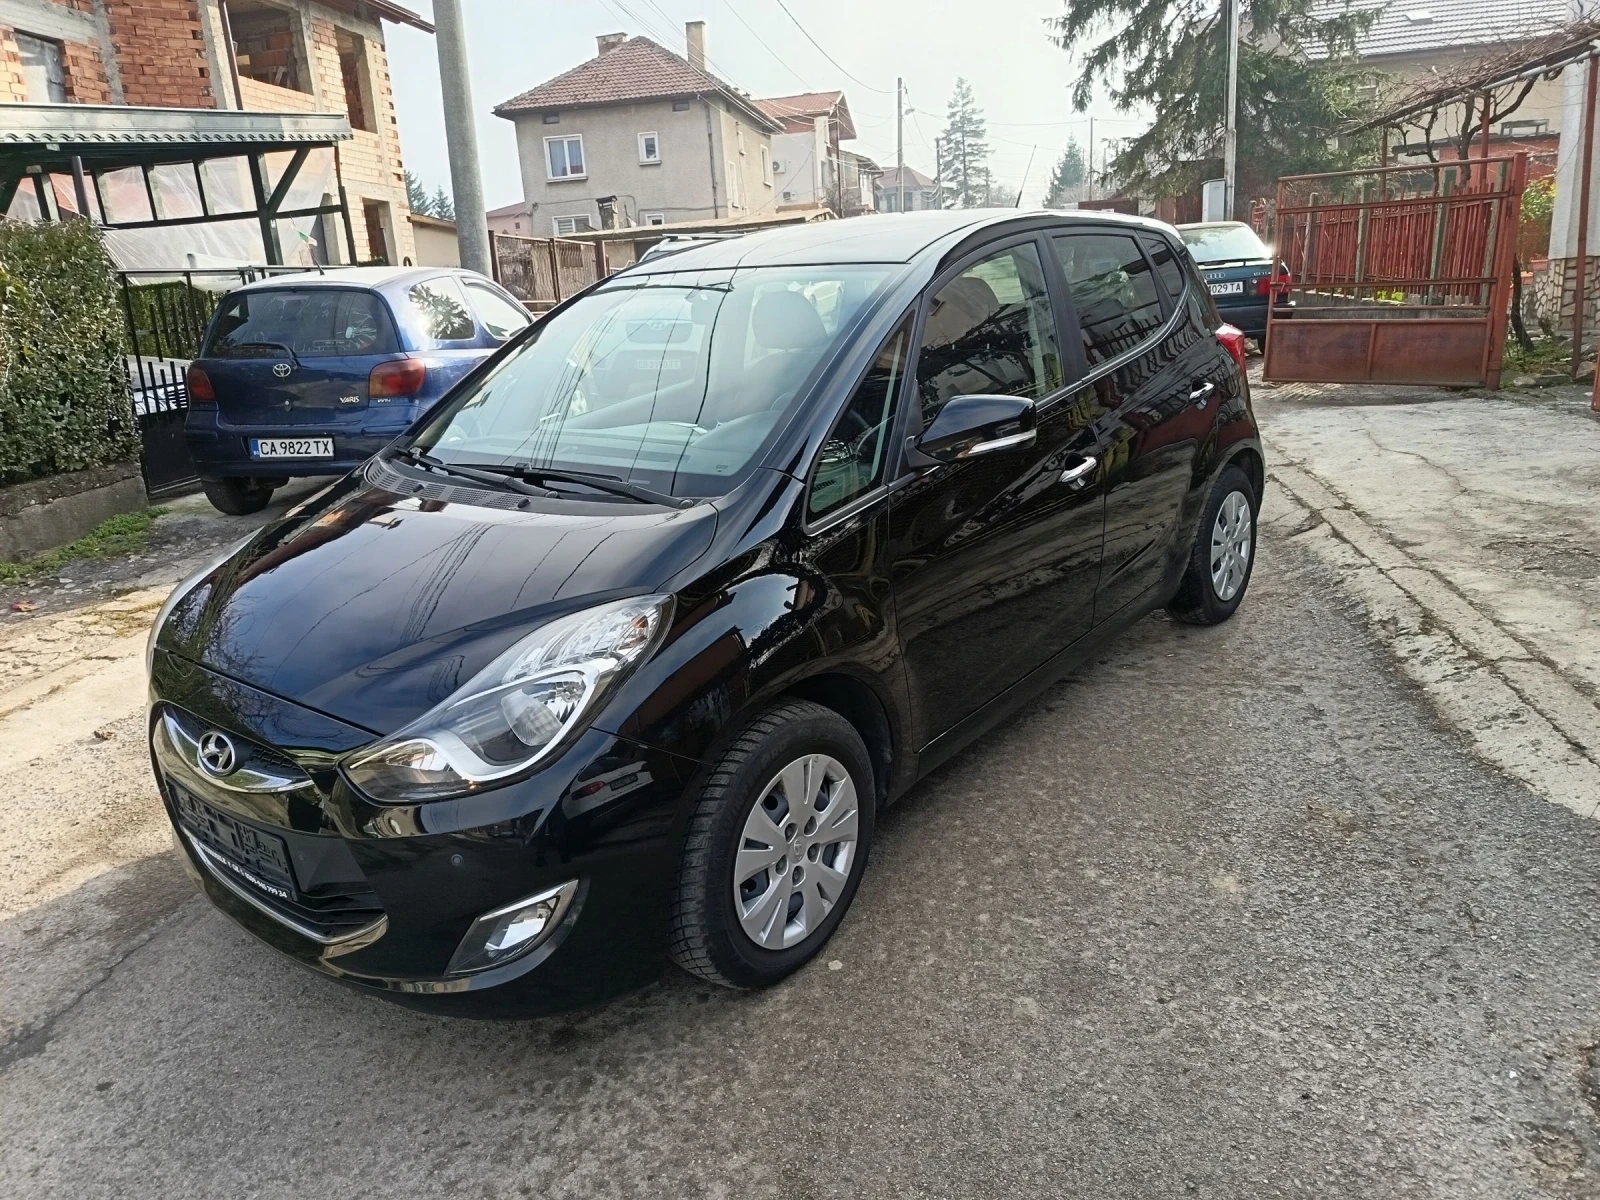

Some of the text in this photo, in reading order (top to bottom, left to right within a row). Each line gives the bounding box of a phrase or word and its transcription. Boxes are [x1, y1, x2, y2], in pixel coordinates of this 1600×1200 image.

[1230, 282, 1241, 292] TA
[339, 395, 360, 404] YARIS
[260, 440, 330, 456] CA 9822 TX
